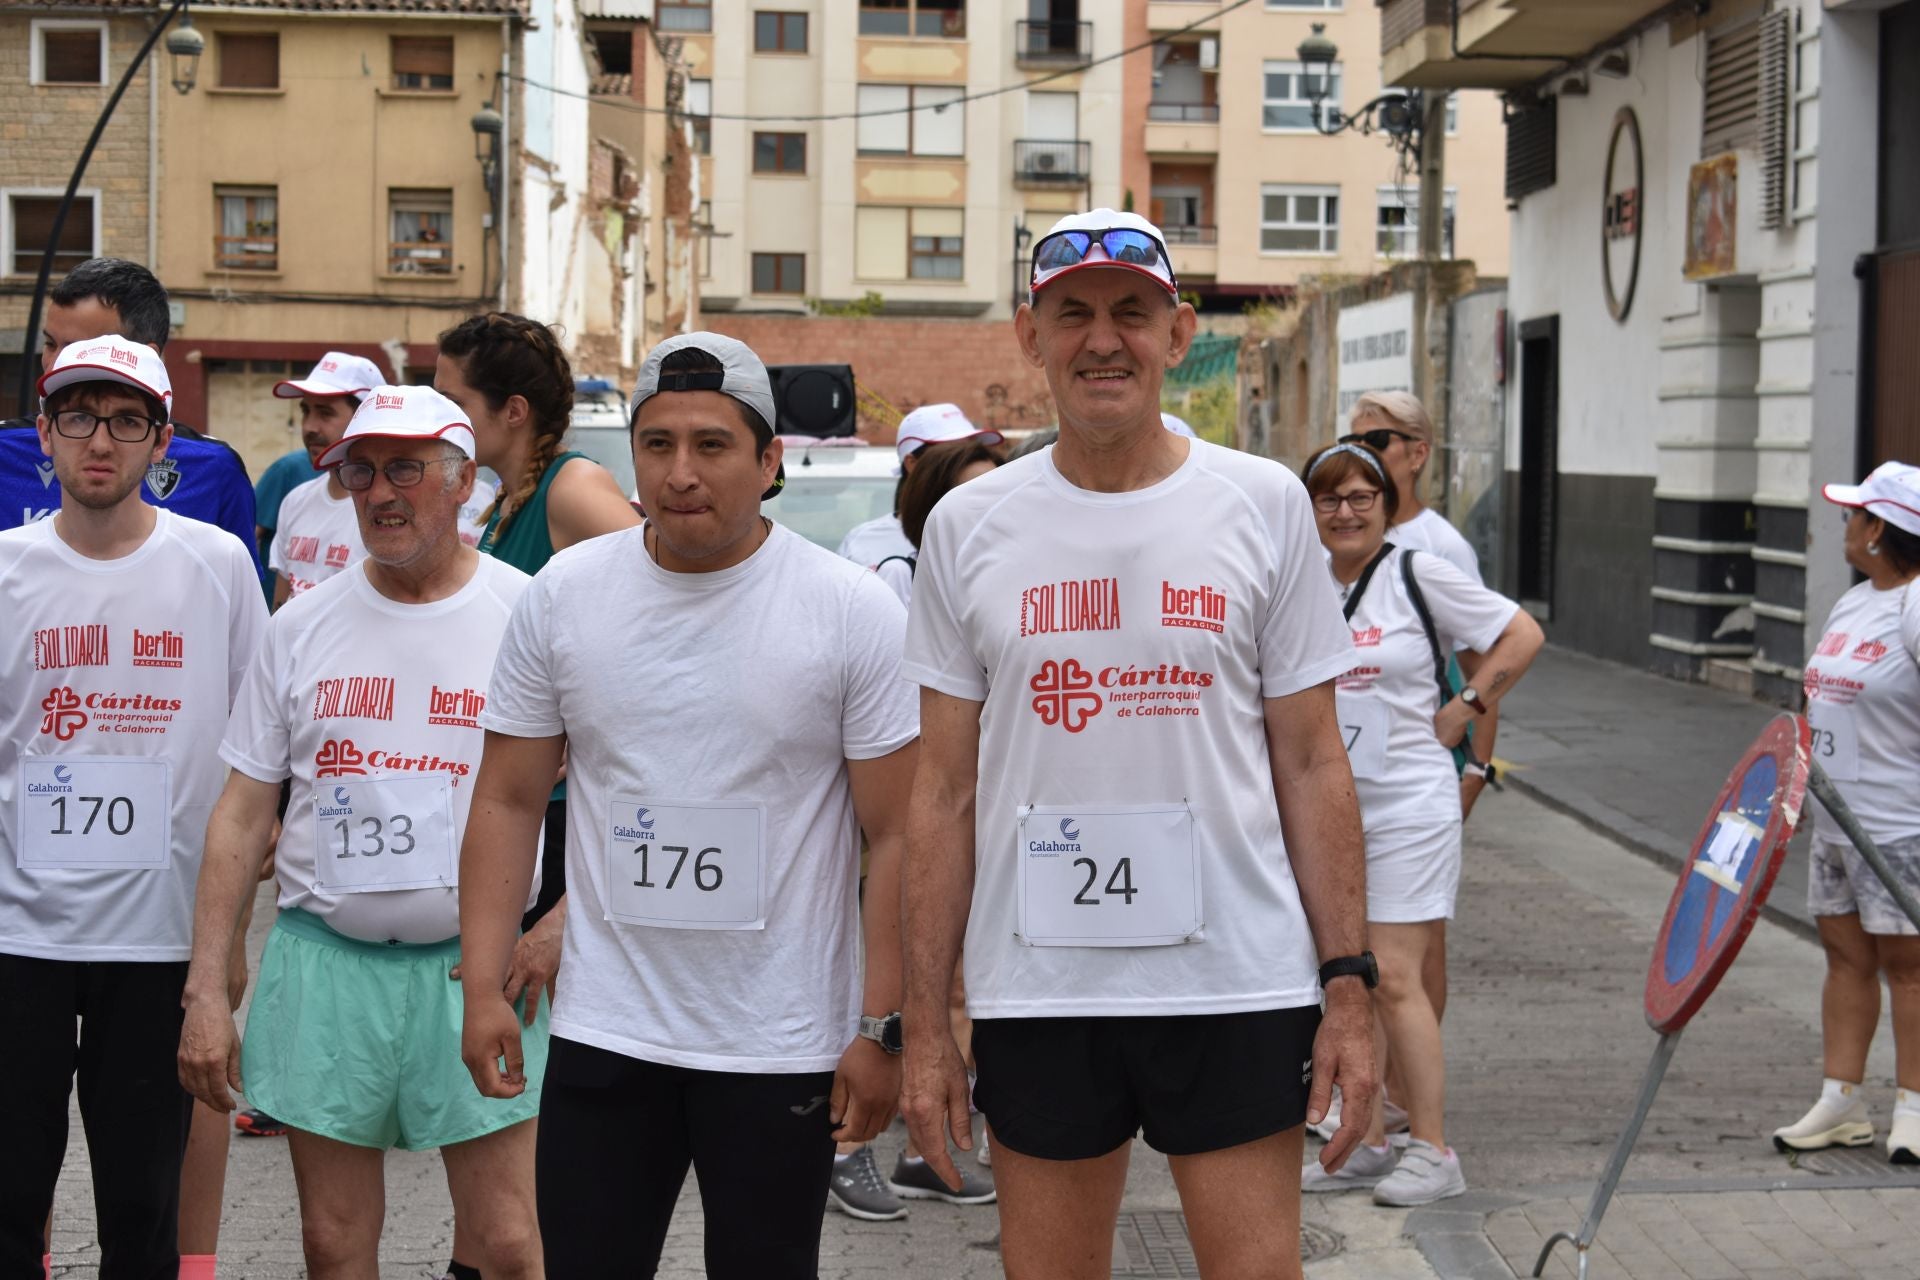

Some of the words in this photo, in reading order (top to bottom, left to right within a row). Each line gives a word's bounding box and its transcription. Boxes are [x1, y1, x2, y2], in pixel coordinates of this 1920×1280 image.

[110, 345, 139, 366] berlin
[376, 393, 404, 406] berlin
[1021, 589, 1029, 637] MARCHA
[1029, 578, 1121, 635] SOLIDARIA
[1162, 580, 1226, 622] berlin
[1164, 619, 1223, 632] PACKAGING
[40, 624, 109, 670] SOLIDARIA
[133, 629, 183, 659] berlin
[1098, 664, 1214, 688] Cáritas
[85, 692, 182, 711] Cáritas
[313, 680, 323, 720] MARCHA
[319, 676, 395, 722] SOLIDARIA
[430, 685, 486, 717] berlin
[1117, 707, 1132, 717] de
[1135, 705, 1199, 716] Calahorra
[93, 712, 173, 724] Interparroquial
[97, 724, 111, 733] de
[114, 725, 166, 734] Calahorra
[430, 718, 479, 728] PACKAGIN
[28, 783, 73, 793] Calahorra
[50, 796, 135, 836] 170
[334, 814, 416, 859] 133
[613, 826, 655, 840] Calahorra
[1029, 841, 1081, 852] Calahorra
[633, 843, 723, 891] 176
[1073, 857, 1138, 905] 24
